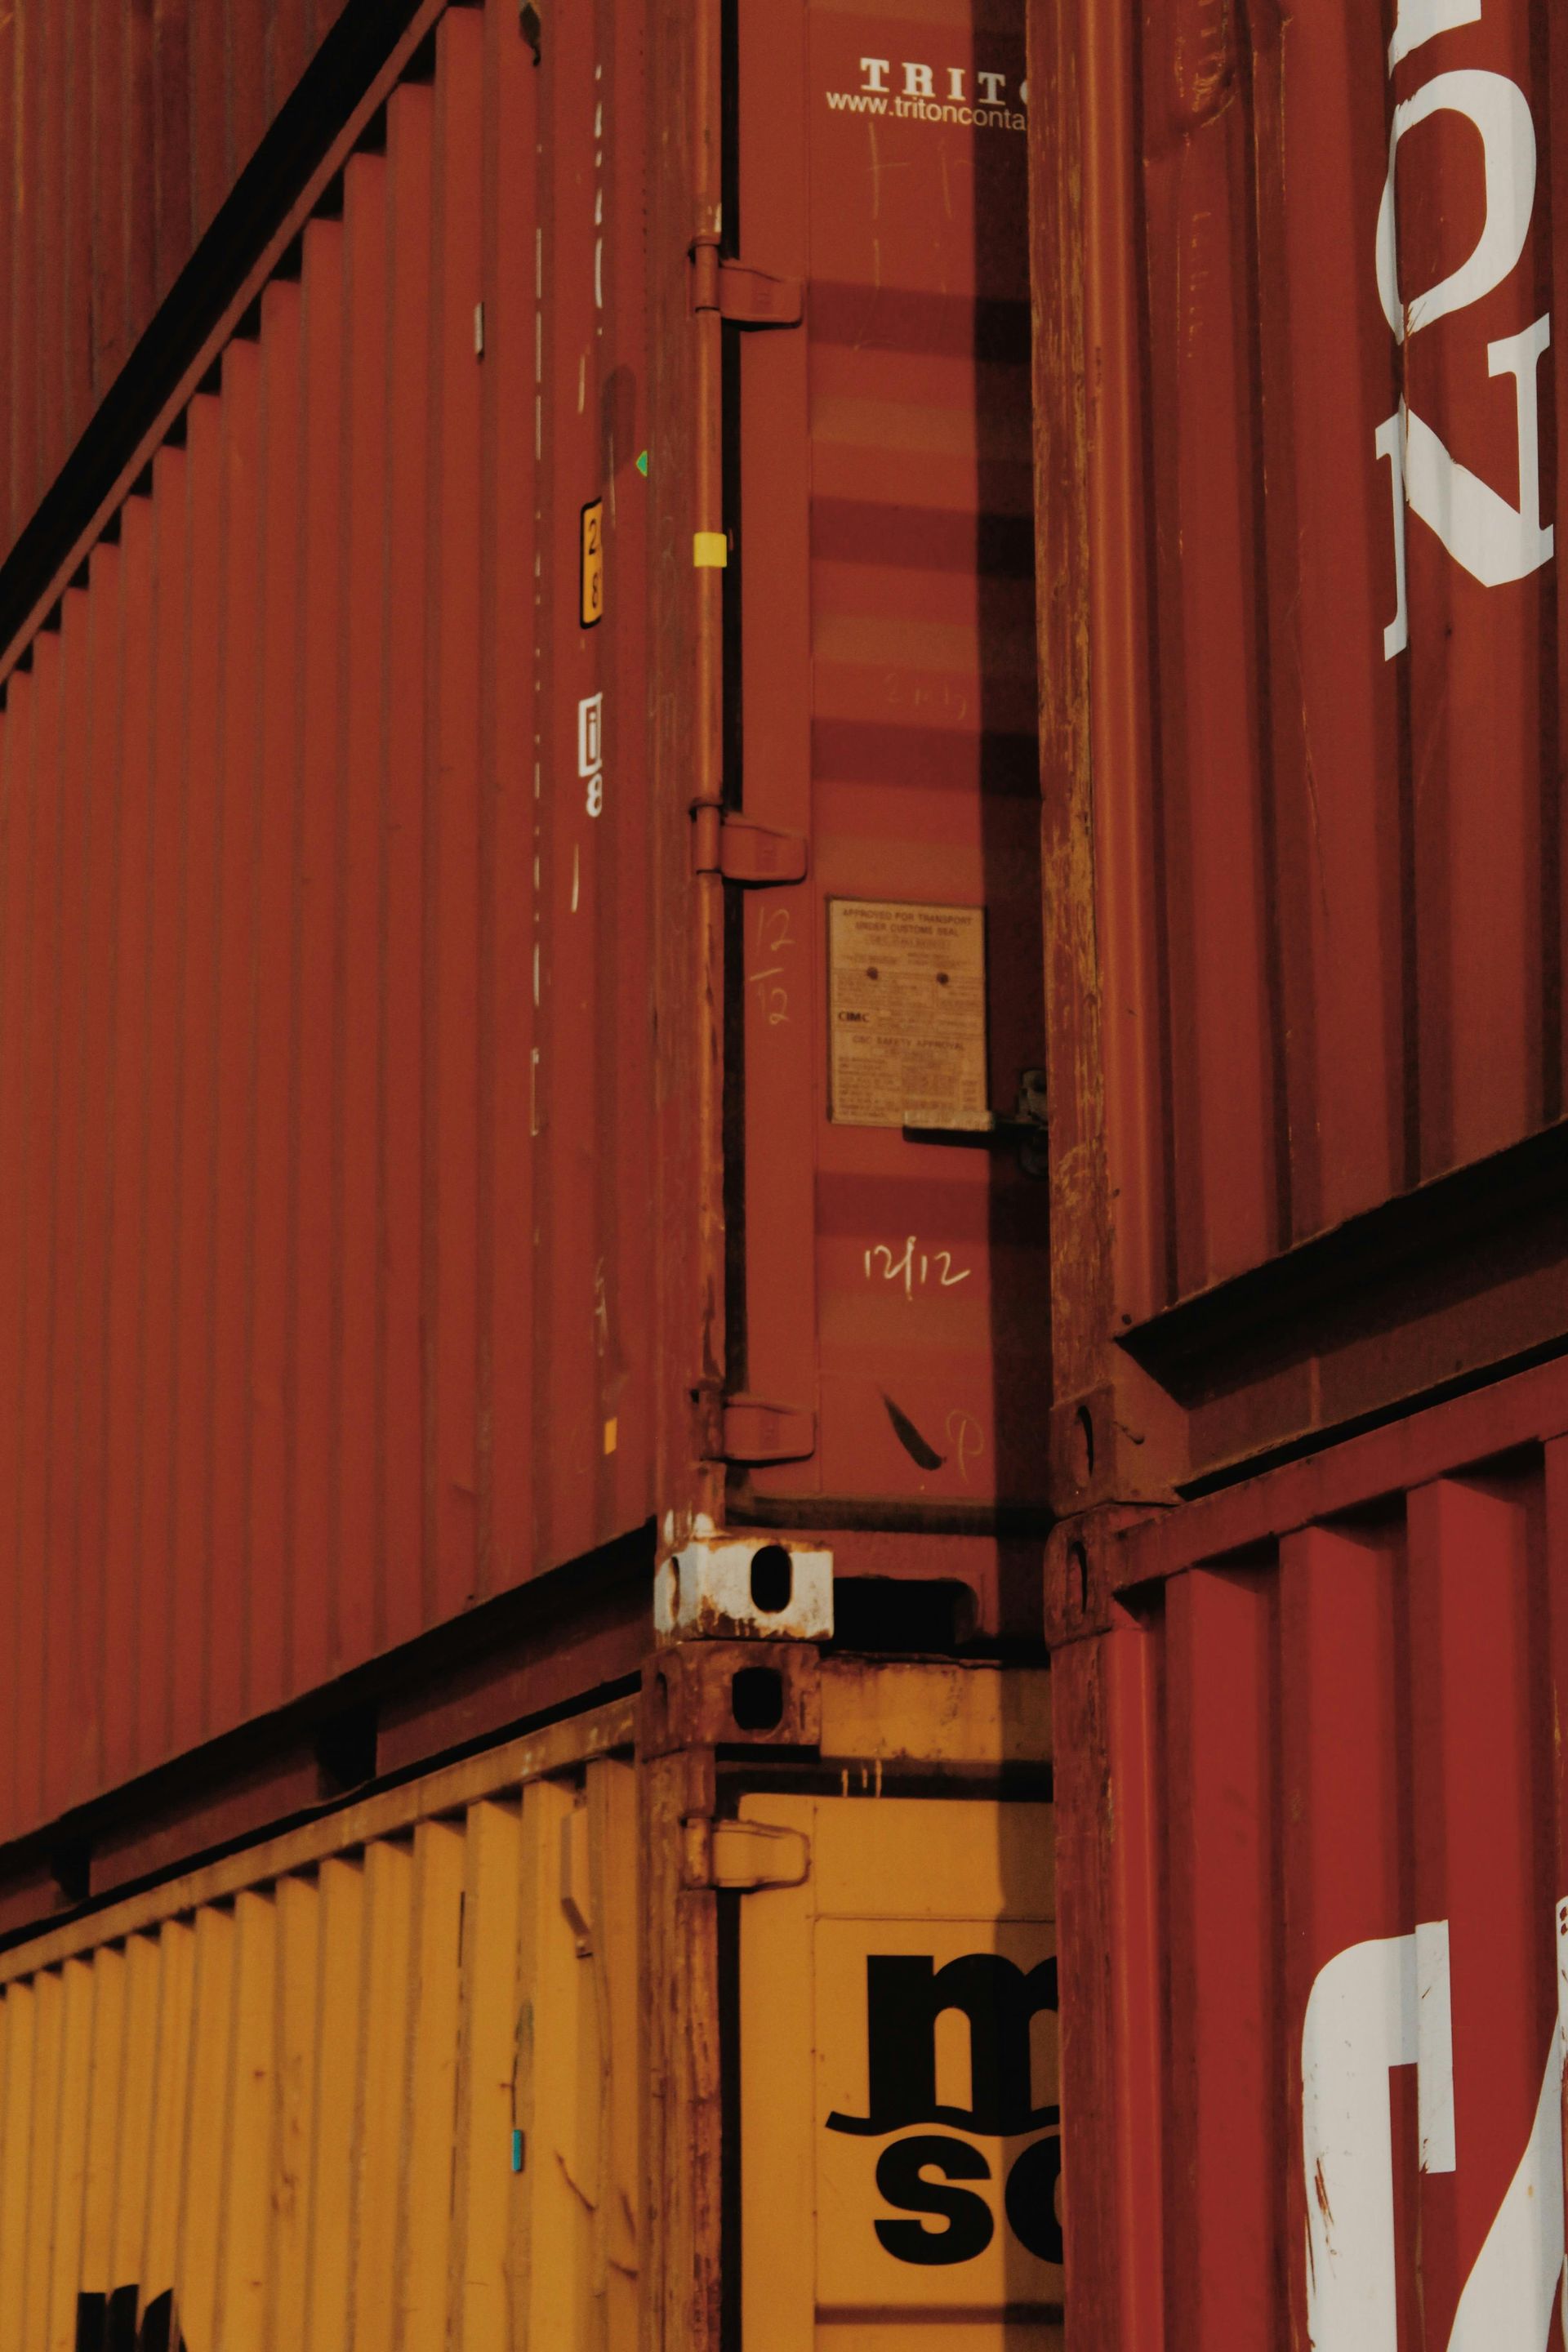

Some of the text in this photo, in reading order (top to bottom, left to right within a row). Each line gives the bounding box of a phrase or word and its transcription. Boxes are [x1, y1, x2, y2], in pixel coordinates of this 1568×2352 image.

[860, 56, 1027, 105] TRIT
[1375, 0, 1556, 662] ON
[843, 908, 973, 925] APPROVED FOR TRANSPORT
[855, 921, 959, 938] UNDER CUSTOMS SEAL
[838, 1011, 870, 1022] CIMC
[877, 1037, 911, 1048] SAFETY
